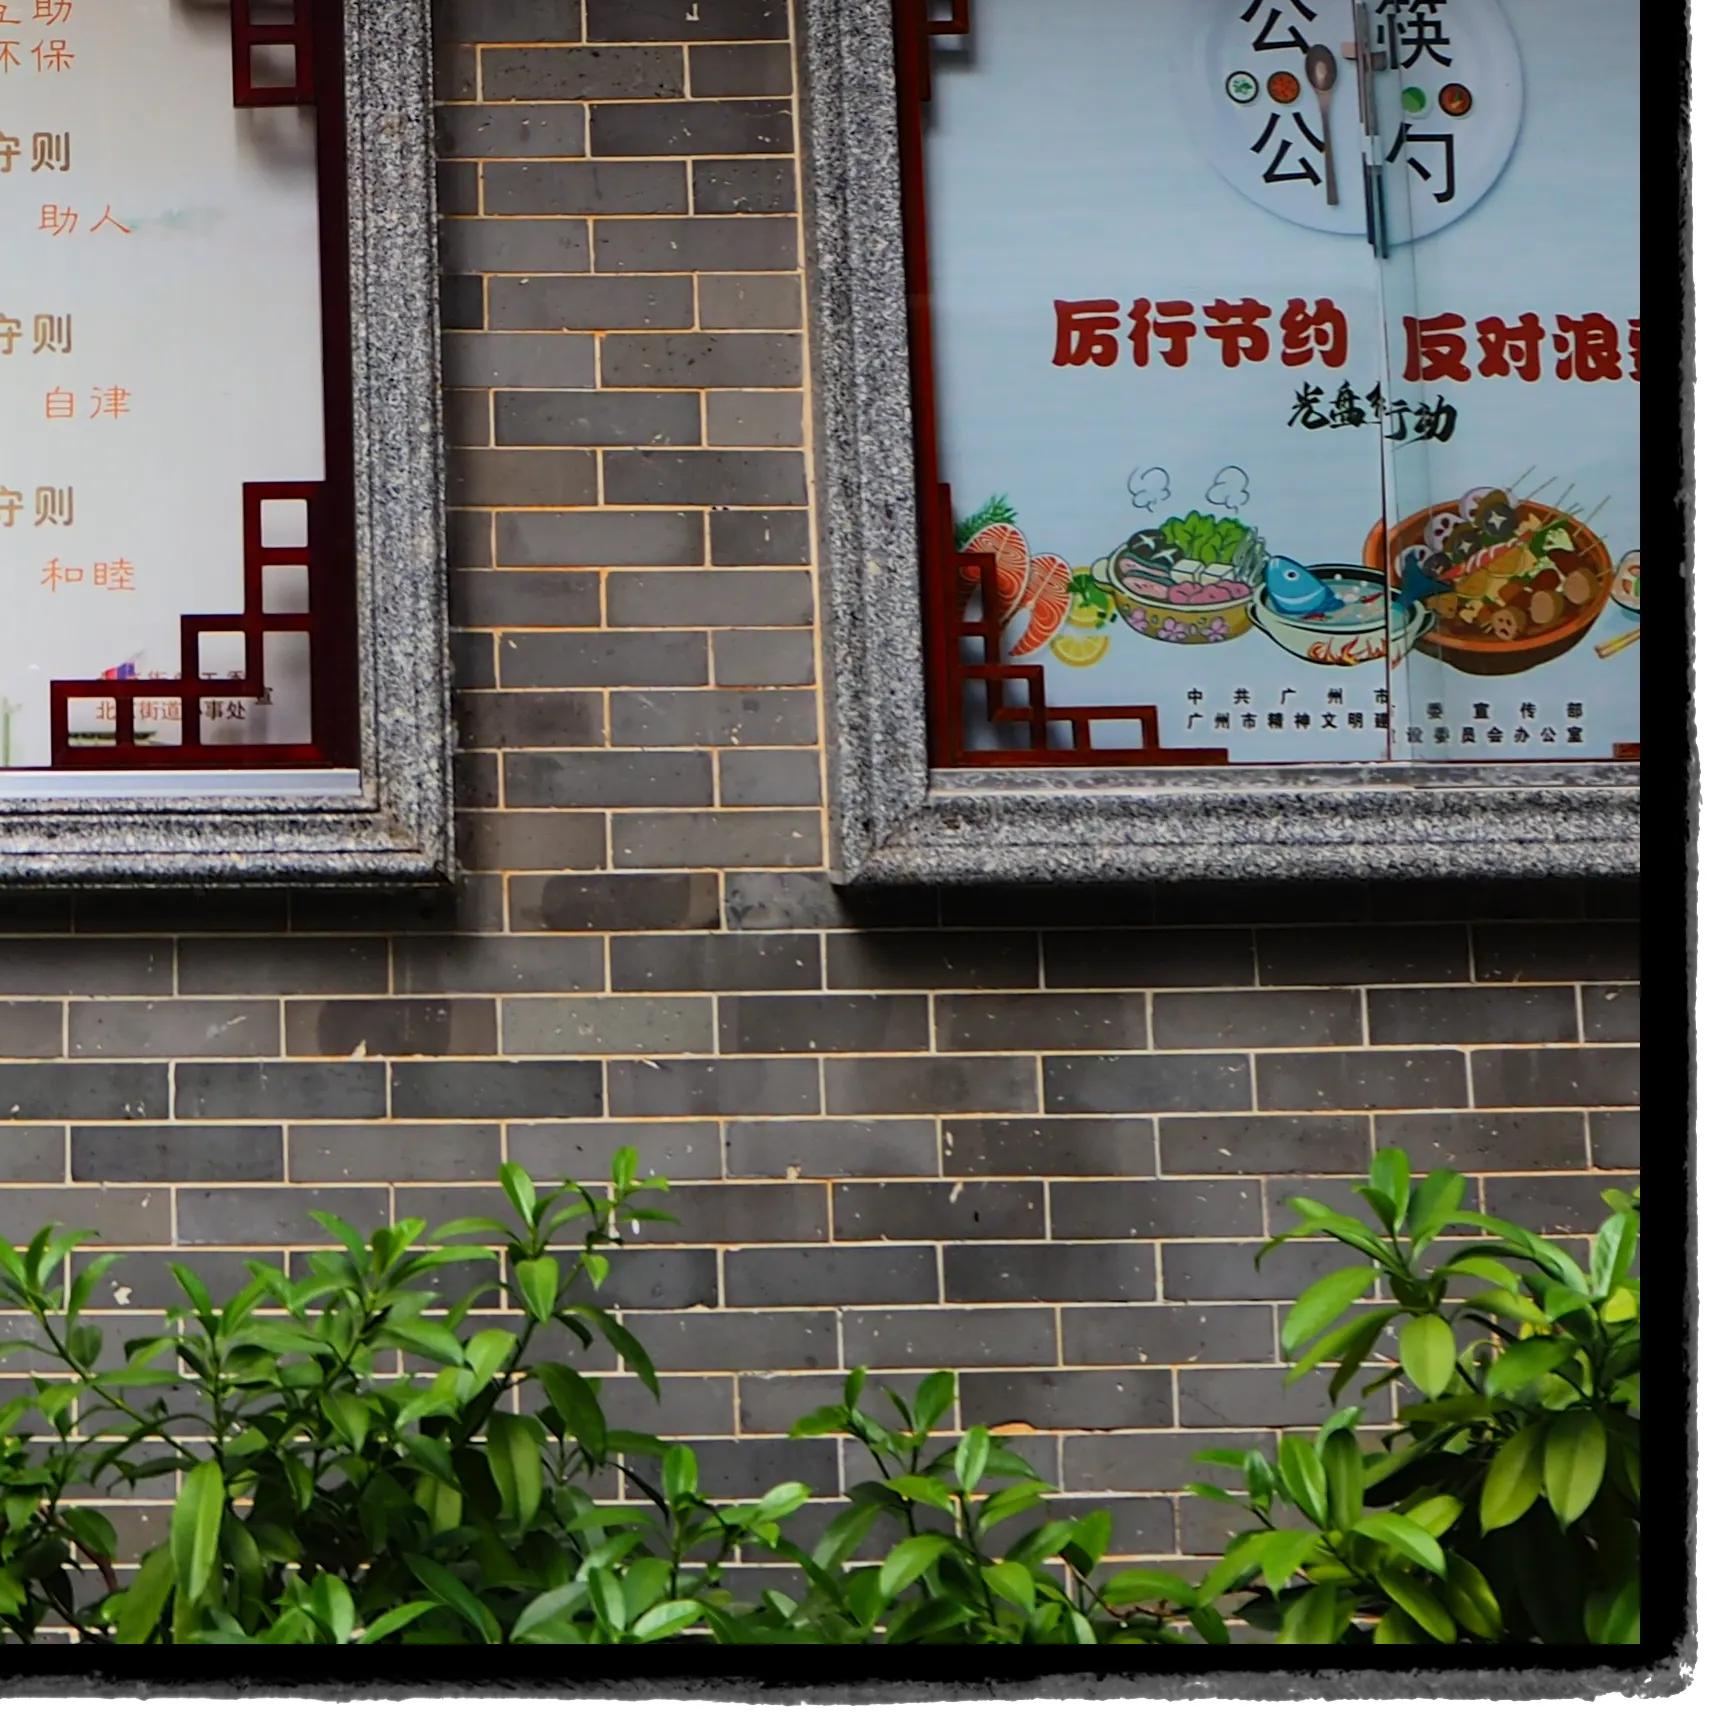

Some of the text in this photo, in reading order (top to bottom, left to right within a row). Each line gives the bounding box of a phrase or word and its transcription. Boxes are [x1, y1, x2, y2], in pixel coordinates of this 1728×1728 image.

[38, 202, 133, 238] 助人
[1052, 298, 1350, 369] 厉行节约
[44, 385, 133, 421] 自律
[41, 557, 138, 593] 和睦
[96, 700, 247, 721] 北街道事处
